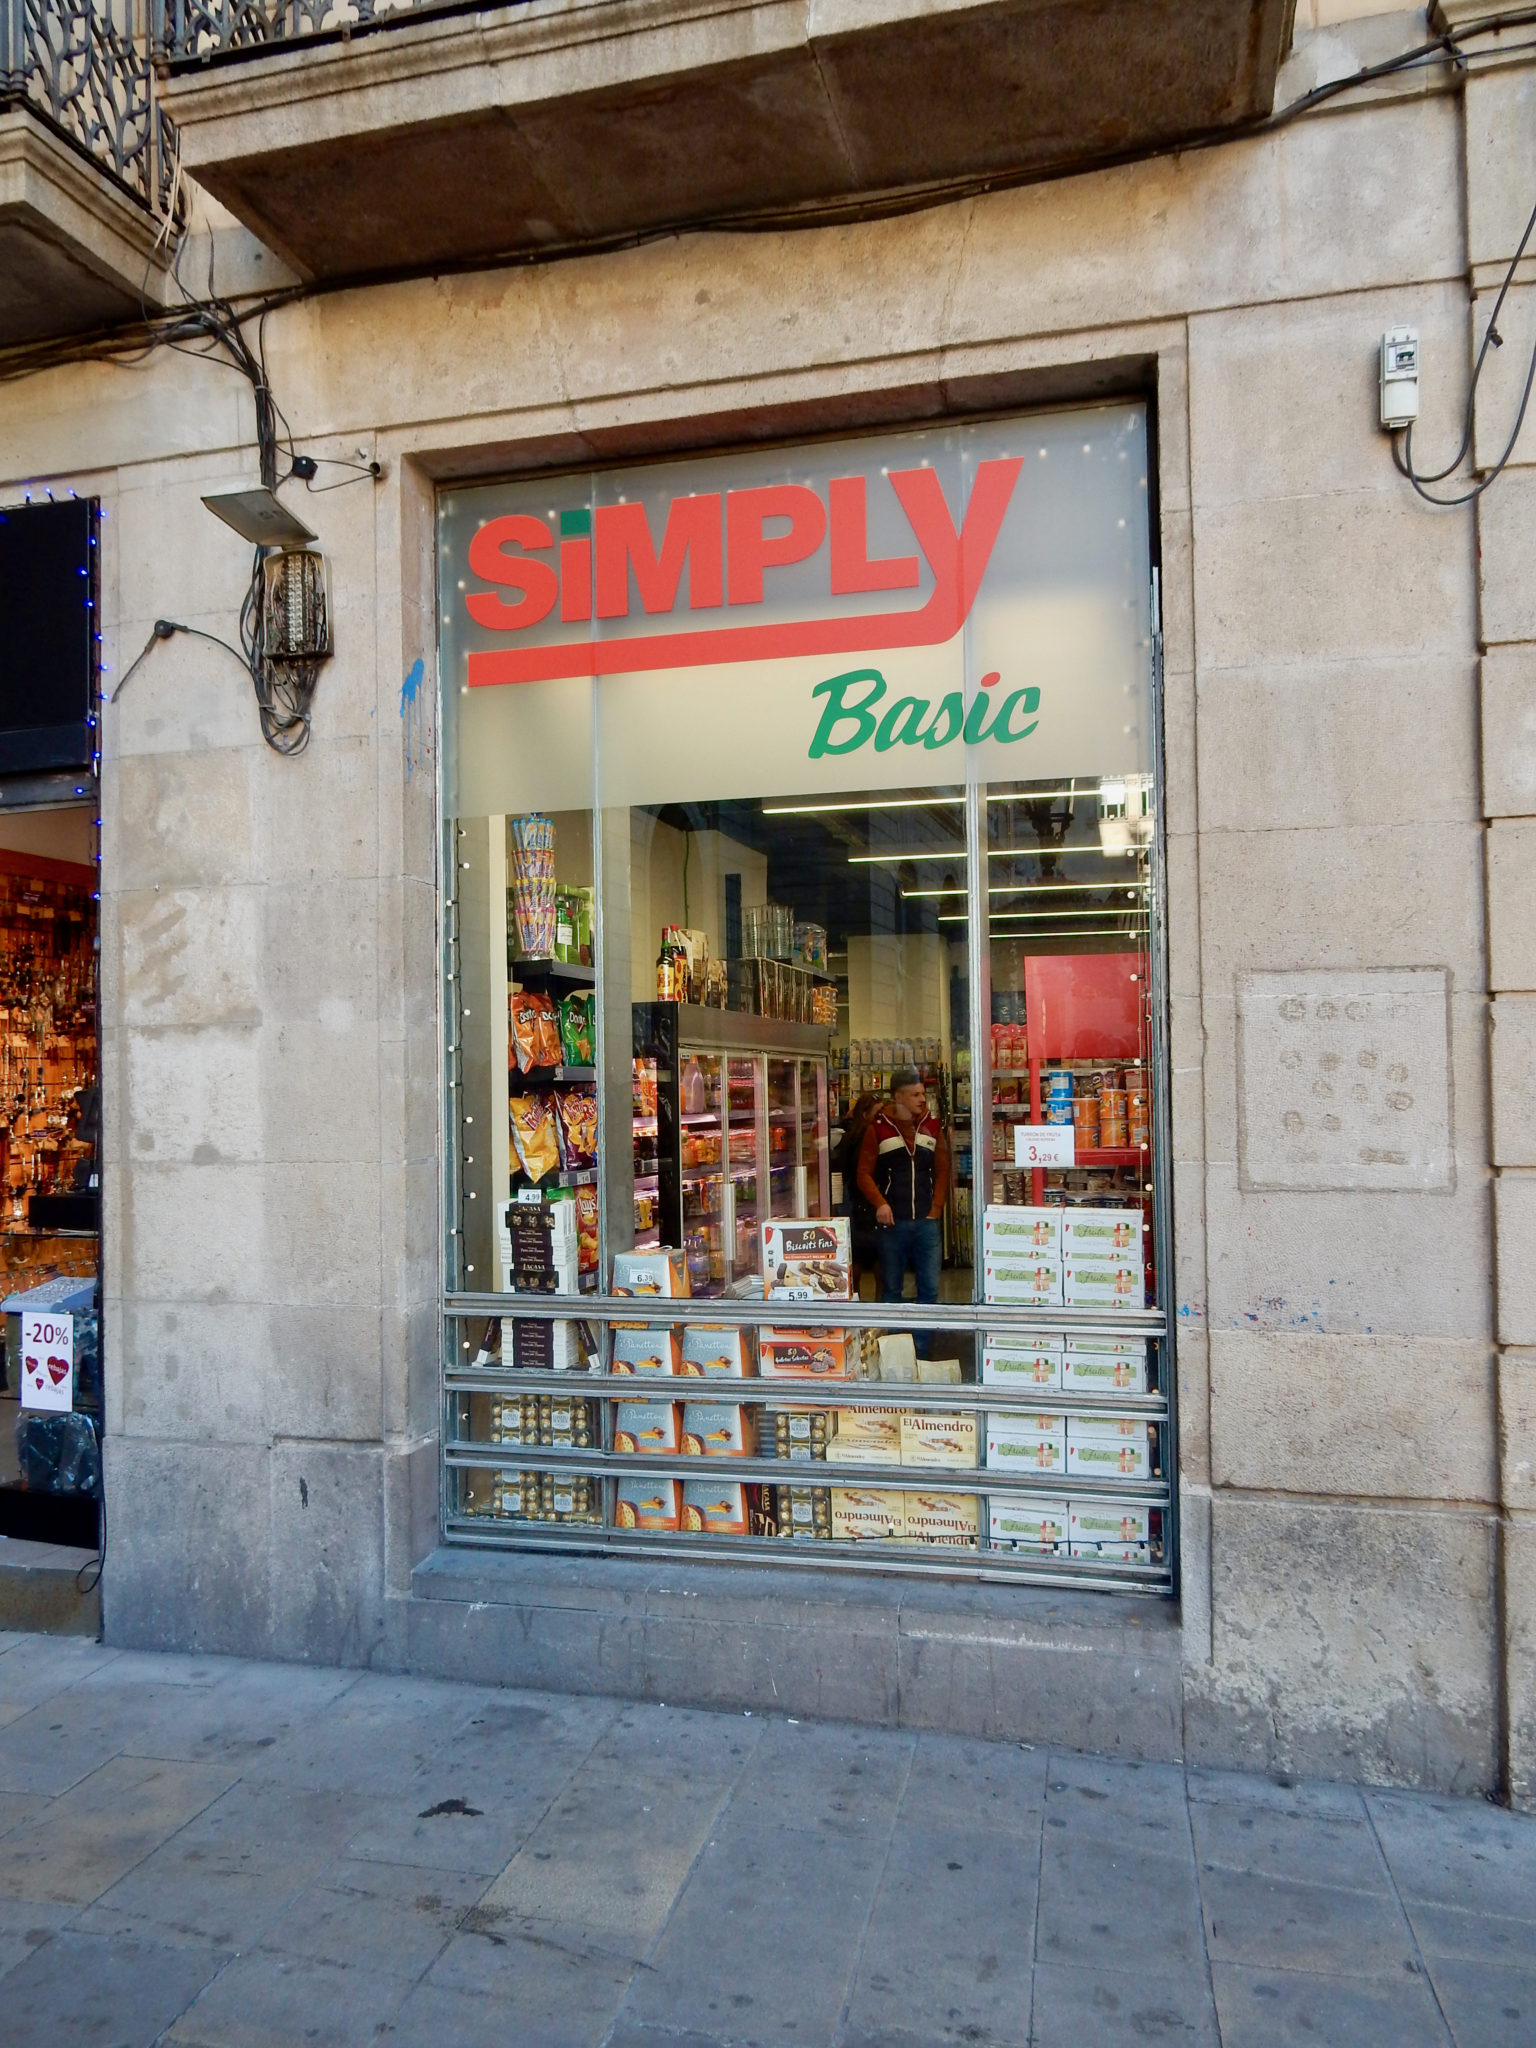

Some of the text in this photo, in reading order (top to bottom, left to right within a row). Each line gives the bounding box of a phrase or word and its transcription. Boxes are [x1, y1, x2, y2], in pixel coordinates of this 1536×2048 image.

[808, 667, 1041, 760] Basic
[1028, 1145, 1060, 1164] 3,29 €
[803, 1230, 816, 1241] 80
[785, 1238, 834, 1252] Biscuits Fins
[25, 1322, 69, 1345] -20%
[912, 1418, 973, 1433] Almendro
[835, 1511, 895, 1526] Almendro
[908, 1516, 969, 1531] Almendro
